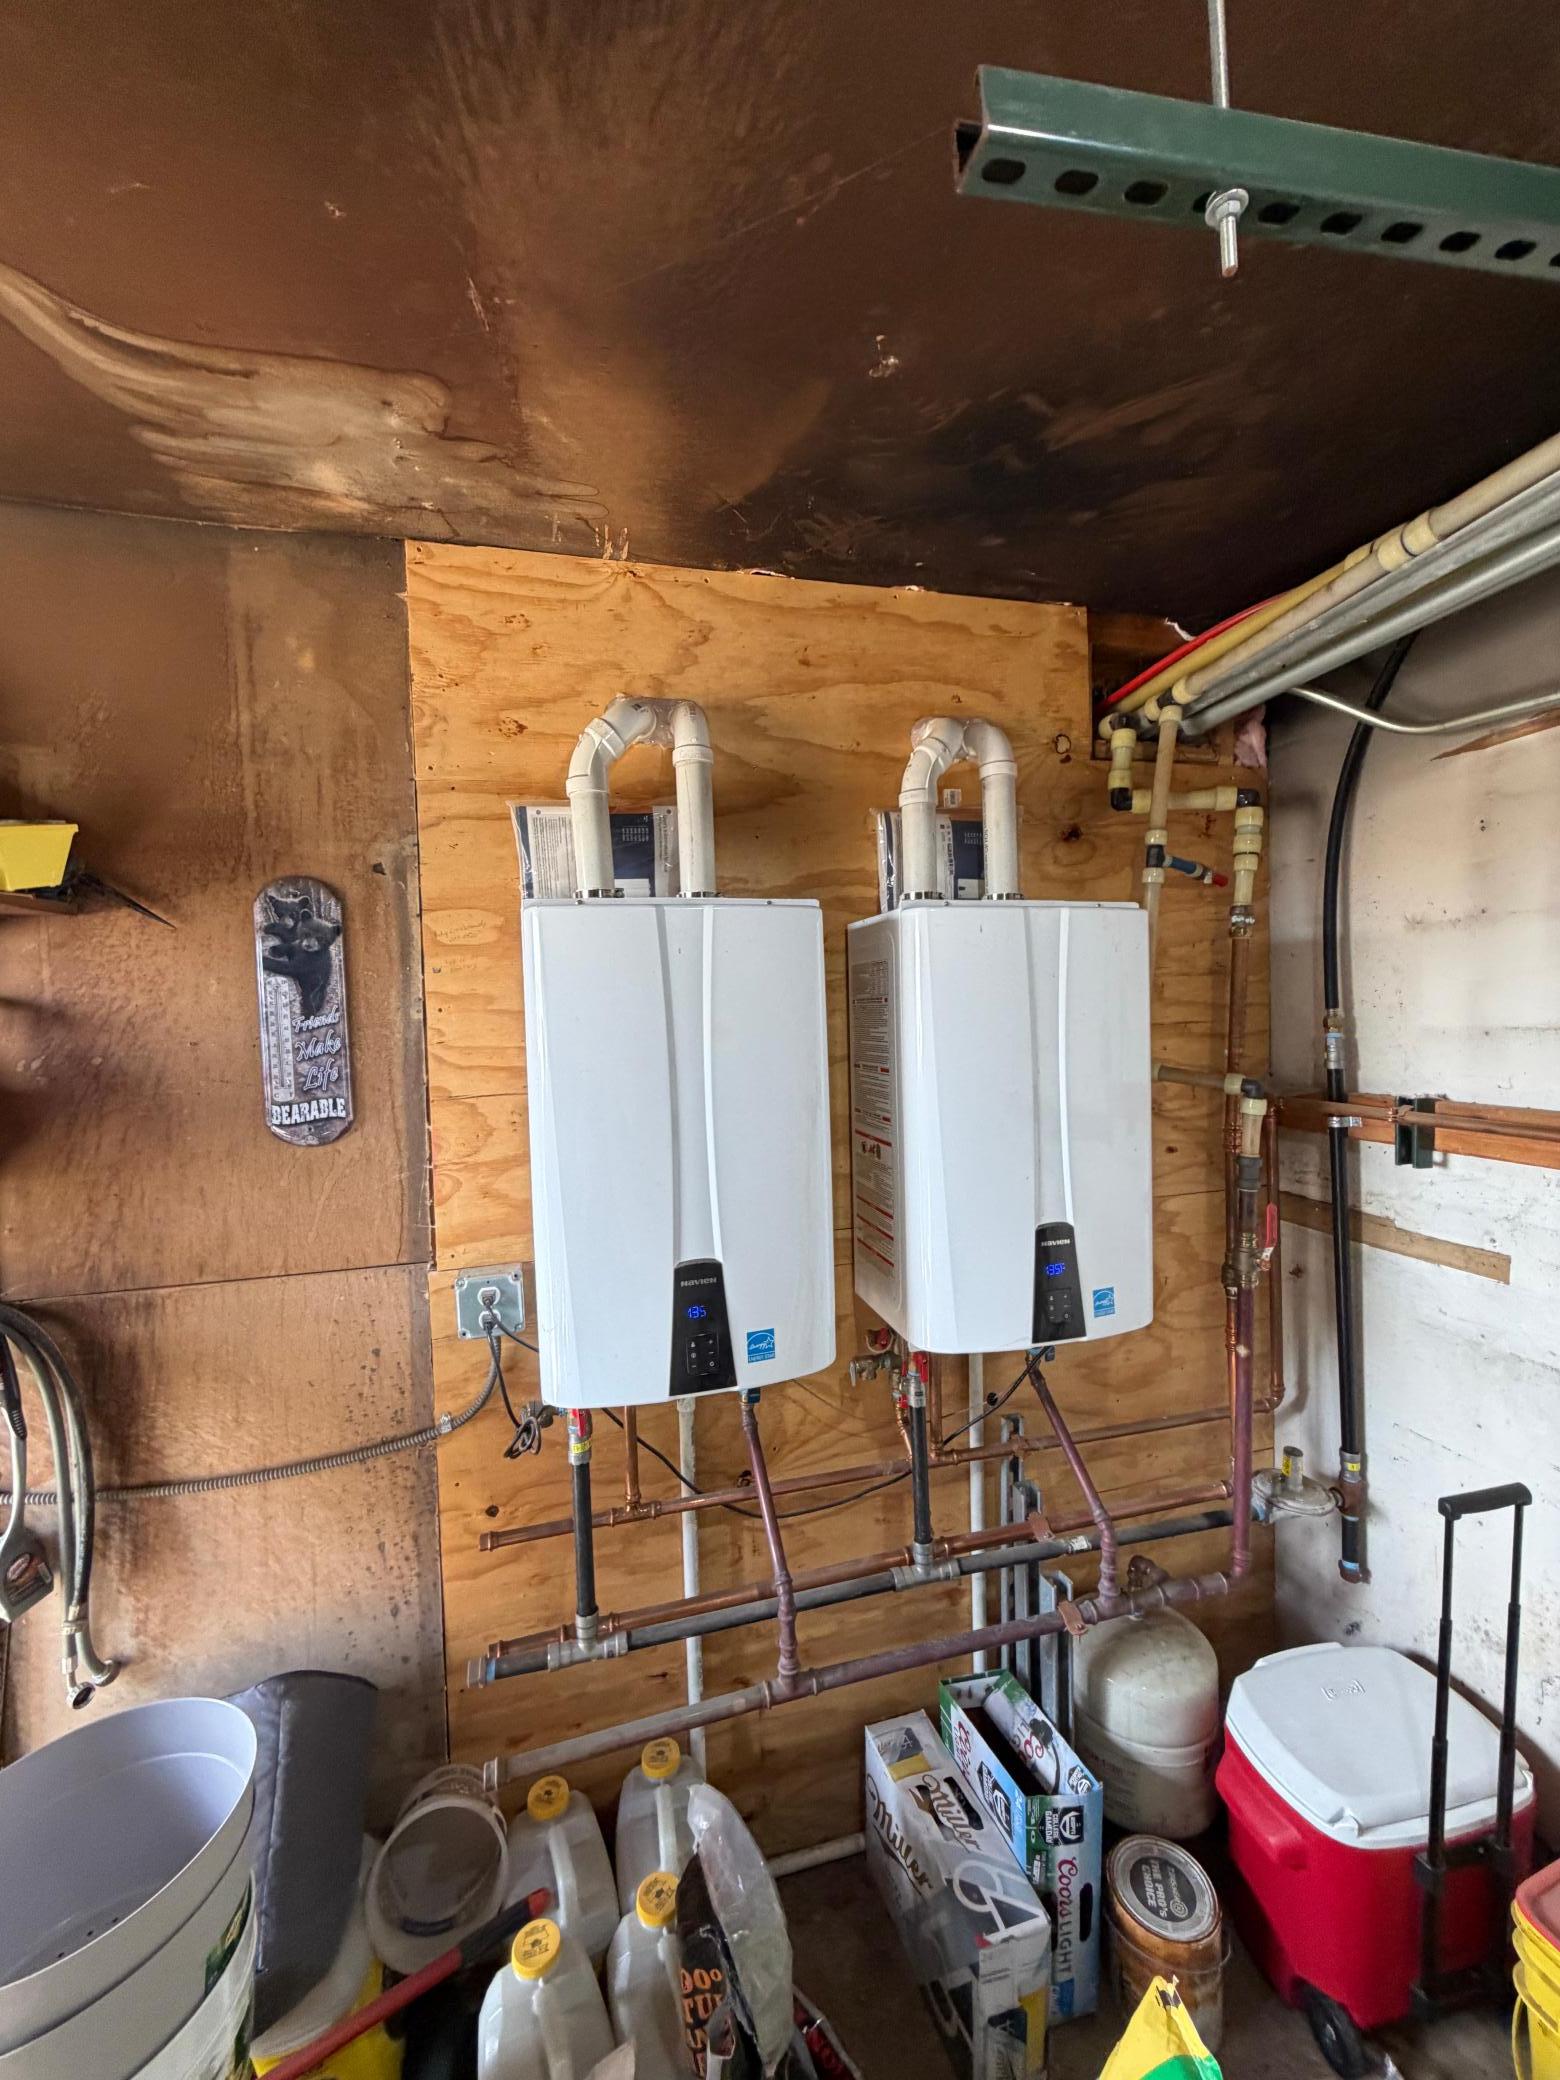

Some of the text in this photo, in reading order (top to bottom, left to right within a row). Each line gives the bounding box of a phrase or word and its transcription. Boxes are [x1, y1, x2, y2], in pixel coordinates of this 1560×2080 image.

[292, 1005, 339, 1033] Friends
[295, 1029, 341, 1061] Make
[303, 1058, 339, 1091] Life
[271, 1098, 346, 1125] BEARABLE
[867, 1773, 933, 1890] Miller
[922, 1774, 982, 1852] Miller
[1141, 1864, 1157, 1908] CHOICE
[1057, 1856, 1078, 1975] Coors LIGHT
